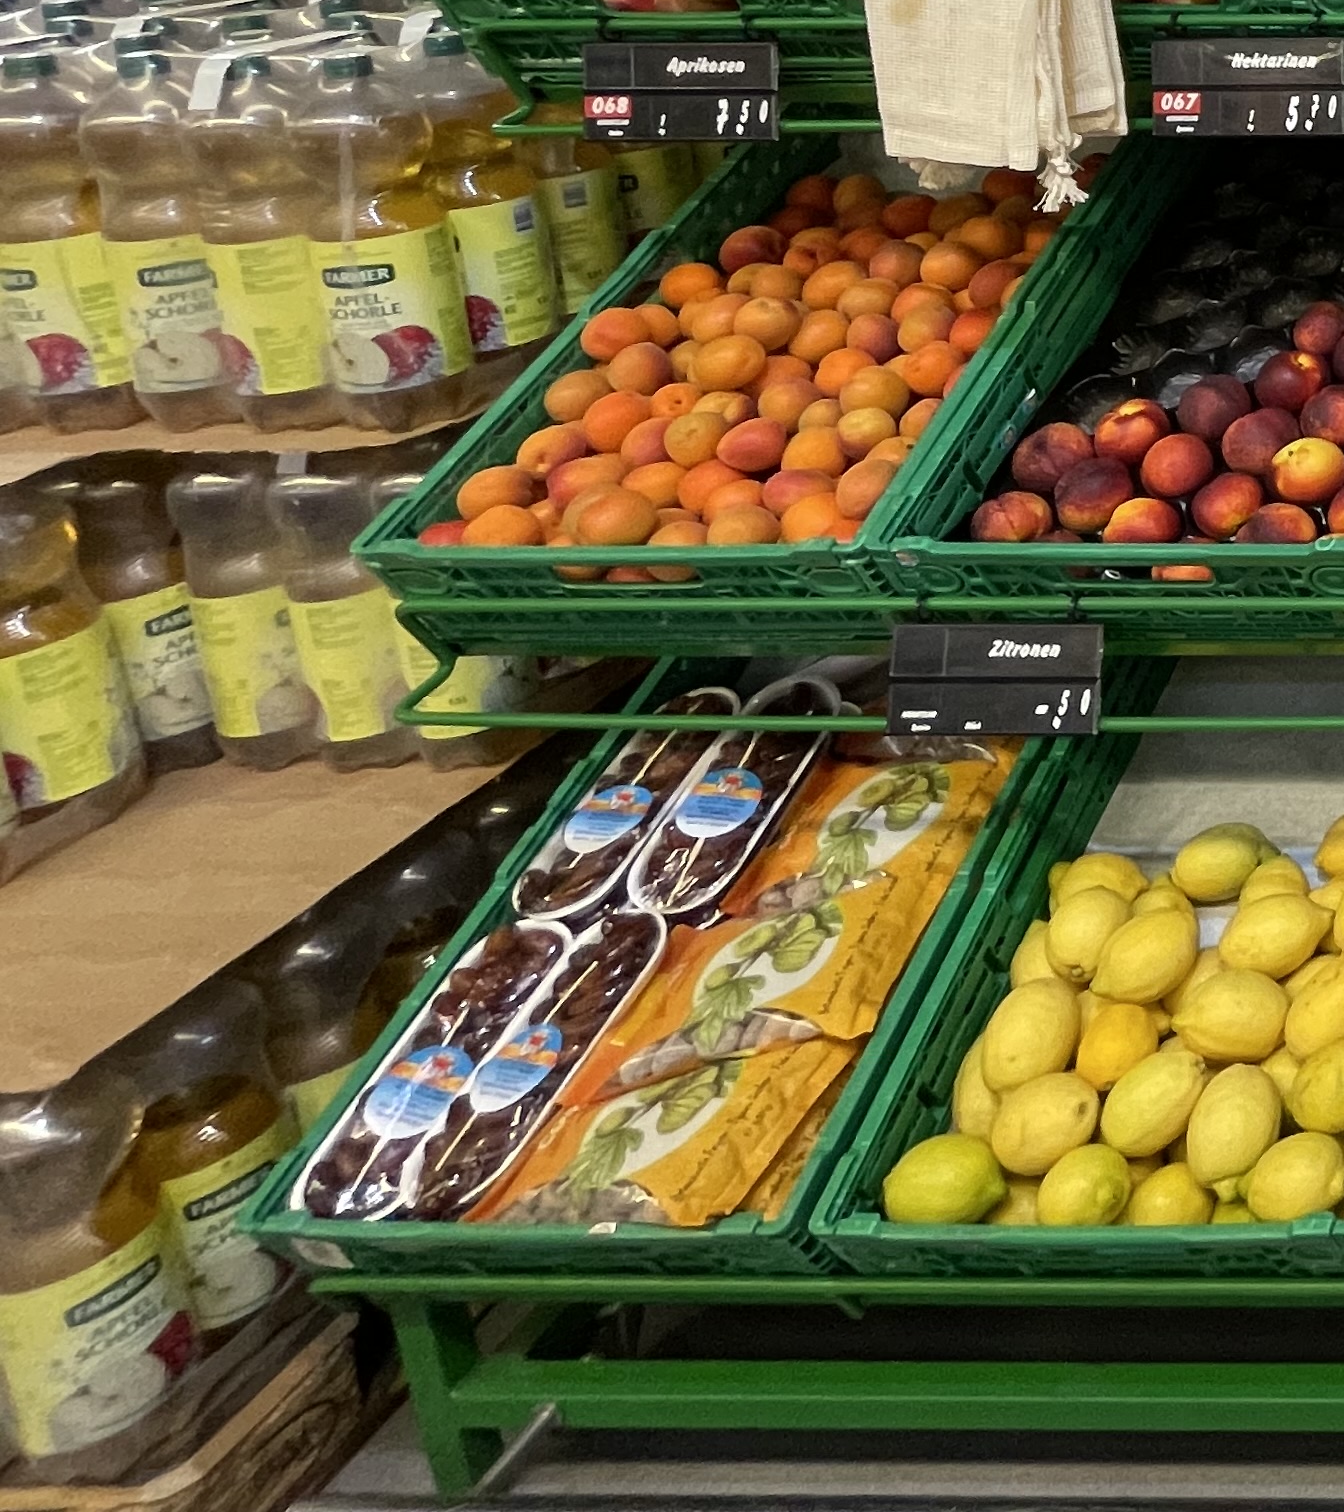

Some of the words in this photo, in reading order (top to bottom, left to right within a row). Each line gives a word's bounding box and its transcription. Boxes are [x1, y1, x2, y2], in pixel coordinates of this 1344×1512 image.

[665, 56, 747, 78] Aprikosen
[1230, 52, 1319, 69] Nektarinen
[591, 96, 630, 115] 068
[1160, 93, 1200, 111] 067
[988, 639, 1062, 658] Zitronen
